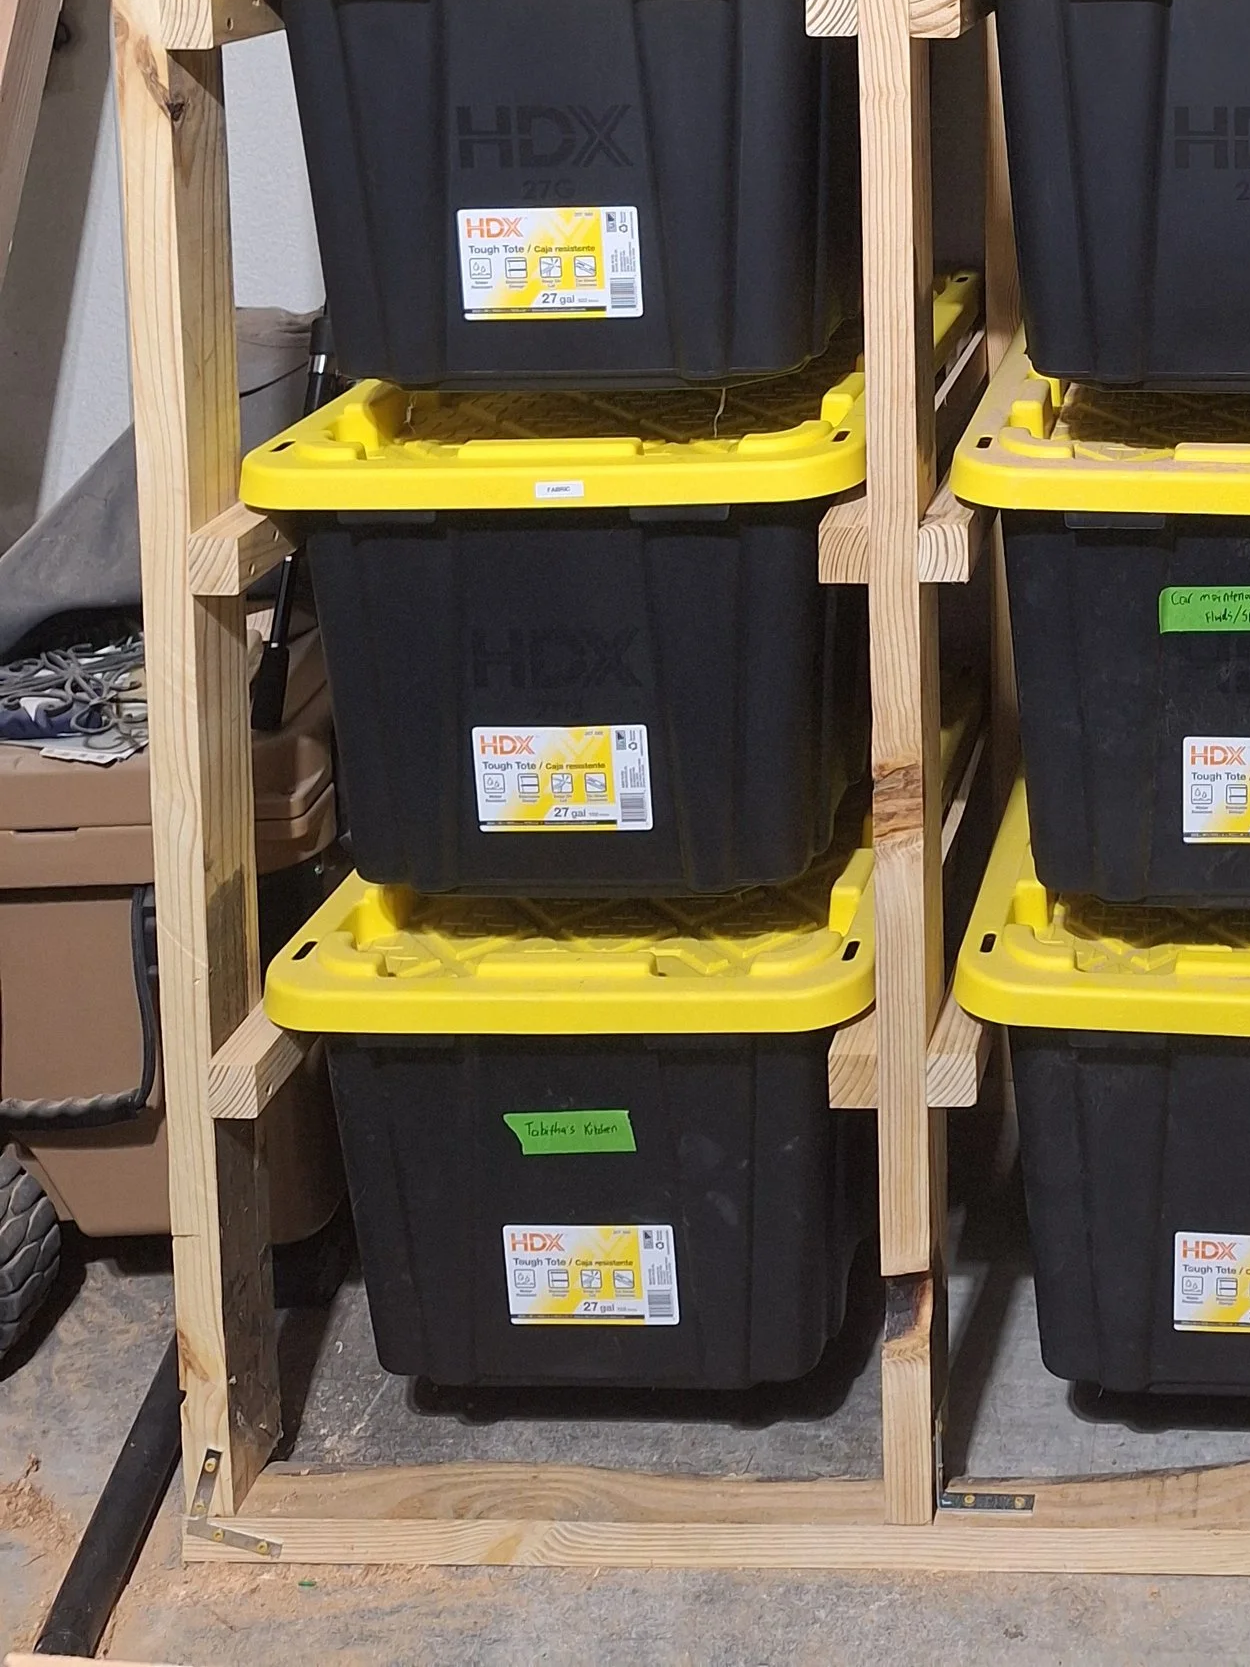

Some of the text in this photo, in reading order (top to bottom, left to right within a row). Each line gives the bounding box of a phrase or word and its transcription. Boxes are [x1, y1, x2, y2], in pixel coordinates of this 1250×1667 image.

[456, 105, 635, 169] HDX
[466, 217, 523, 238] HDX
[469, 245, 499, 255] Tough
[503, 245, 524, 253] Tote
[534, 246, 552, 254] Caja
[542, 293, 557, 304] 27
[560, 294, 574, 305] gal
[1170, 591, 1194, 606] Car
[480, 735, 534, 755] HDX
[1191, 746, 1246, 766] HDX
[483, 762, 513, 771] Tough
[515, 762, 536, 770] Tote
[1192, 772, 1222, 782] Tough
[1225, 772, 1246, 780] Tote
[554, 807, 569, 817] 27
[572, 809, 586, 819] gal
[524, 1121, 618, 1138] Tabitha's Kitchen
[511, 1233, 565, 1252] HDX
[1183, 1240, 1237, 1261] HDX
[513, 1257, 543, 1267] Tough
[545, 1258, 566, 1266] Tote
[575, 1259, 593, 1267] Caja
[1183, 1264, 1212, 1274] Tough
[1215, 1265, 1237, 1275] Tote
[583, 1302, 615, 1313] 27 gal
